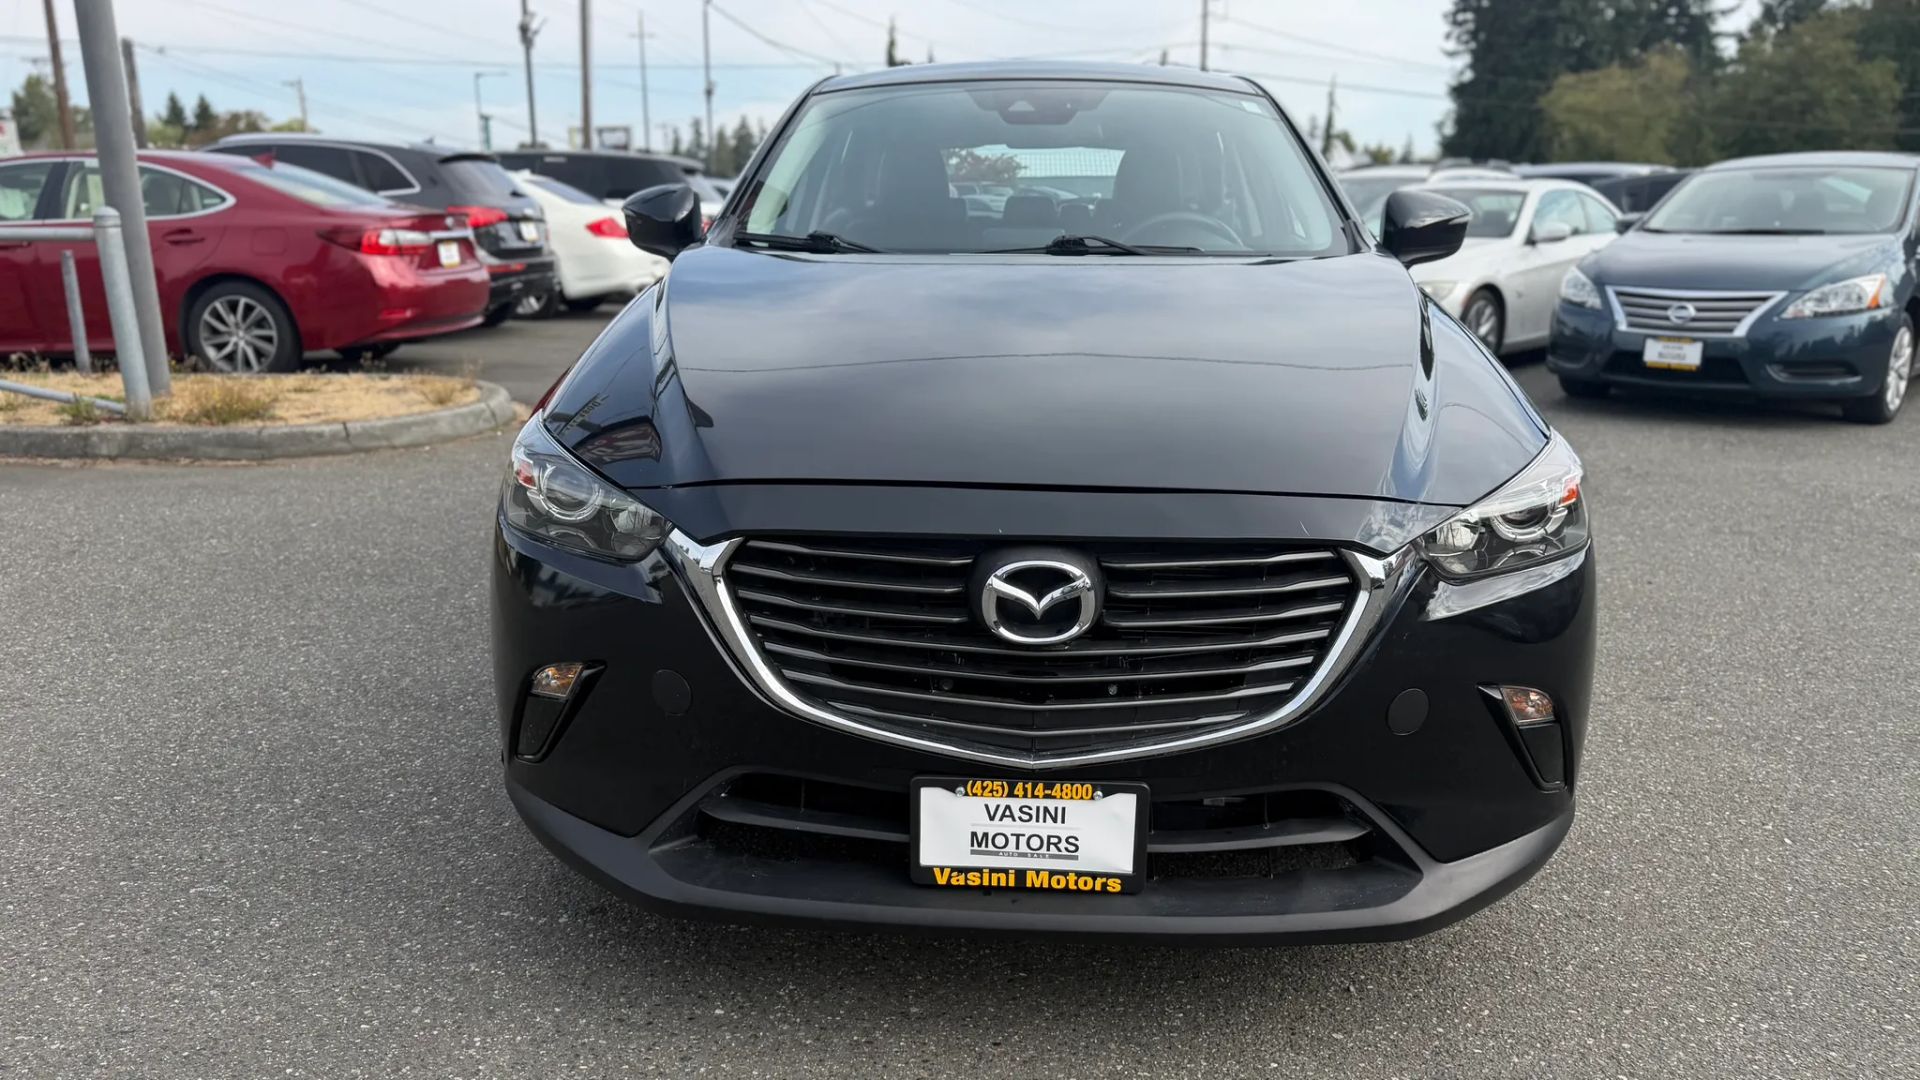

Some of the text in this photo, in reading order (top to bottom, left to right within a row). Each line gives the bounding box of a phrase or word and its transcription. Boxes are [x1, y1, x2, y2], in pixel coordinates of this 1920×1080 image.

[966, 780, 1093, 801] (425) 414-4800
[984, 803, 1067, 824] VASINI
[970, 831, 1080, 853] MOTORS
[933, 867, 1122, 892] Vasini Motors
